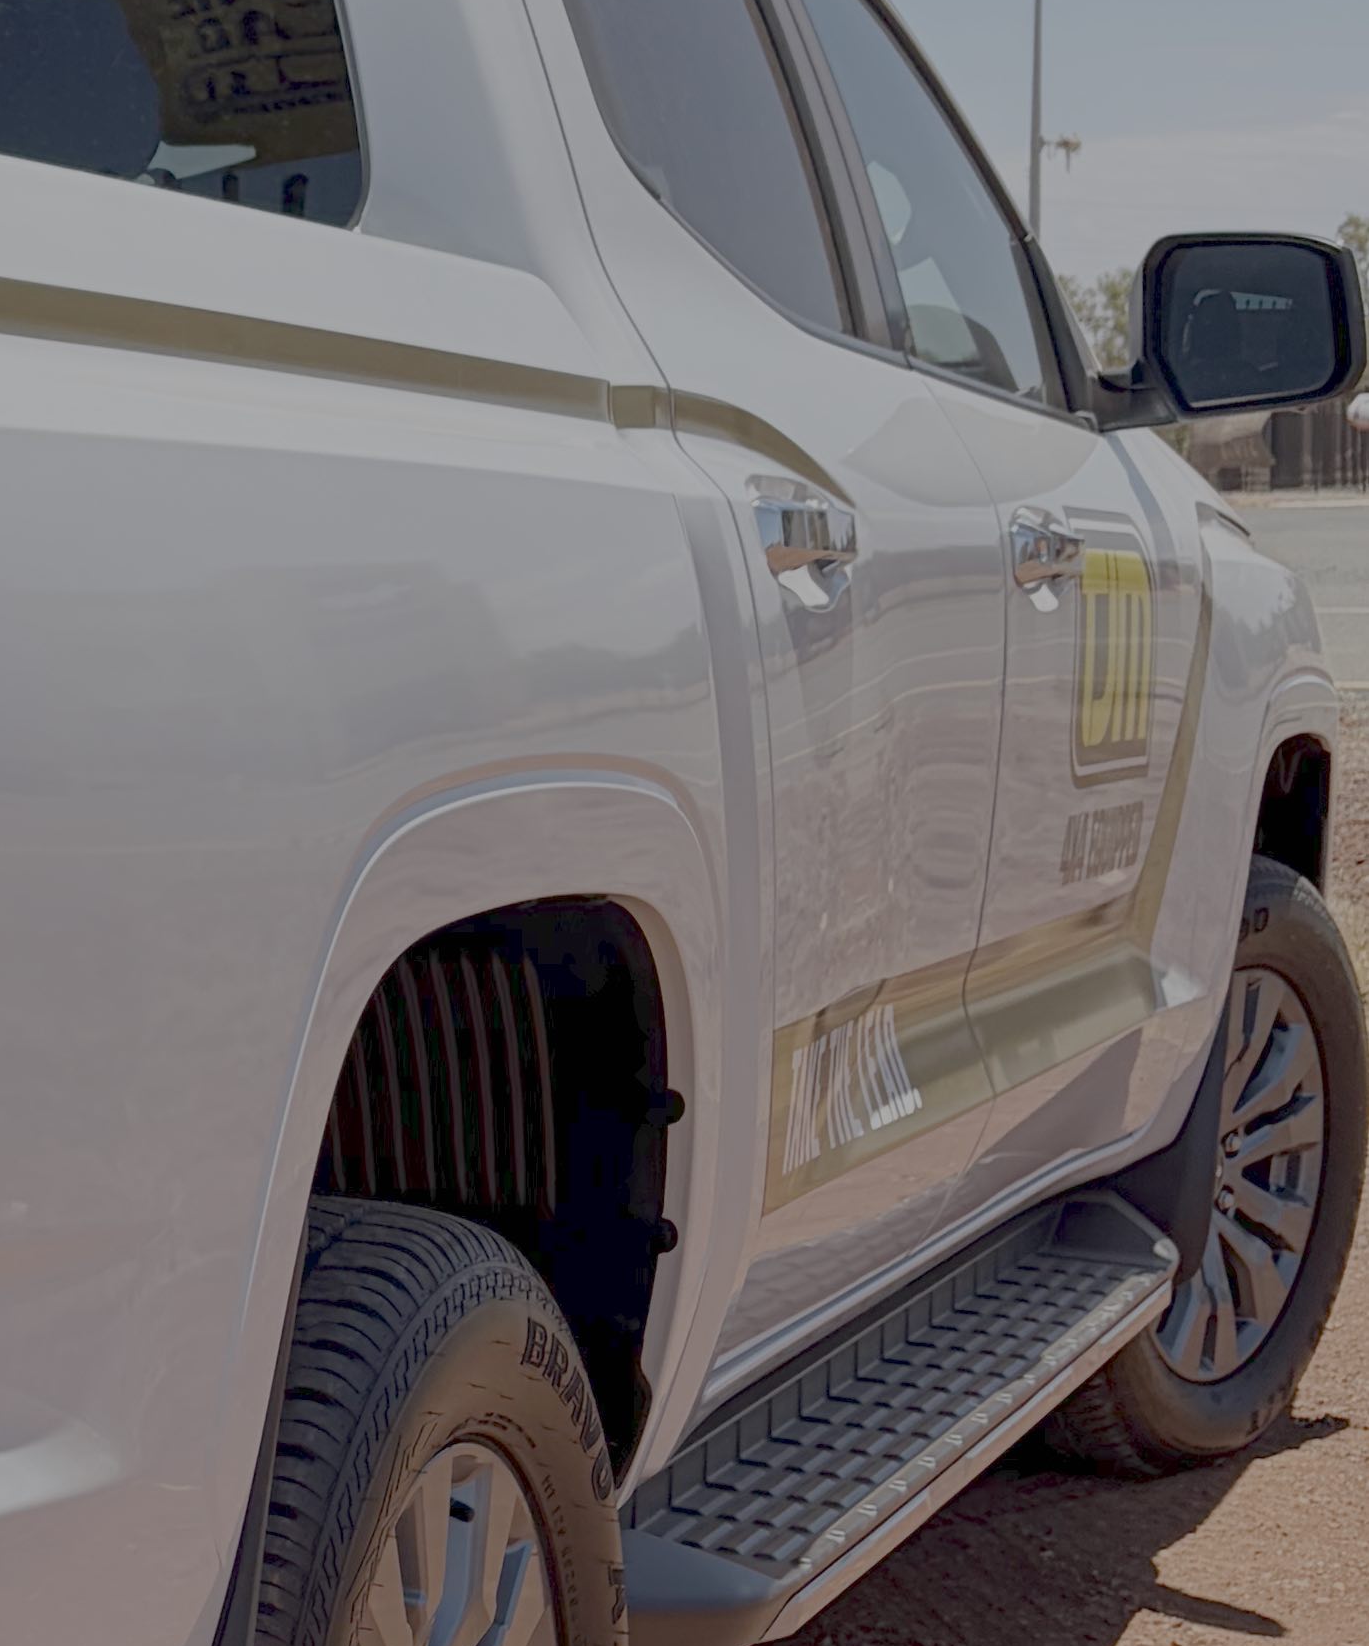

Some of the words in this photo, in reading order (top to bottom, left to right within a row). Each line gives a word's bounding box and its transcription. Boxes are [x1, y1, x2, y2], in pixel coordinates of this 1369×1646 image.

[781, 1034, 828, 1177] TAKE
[826, 1019, 865, 1150] THE
[856, 1002, 923, 1132] LEAD.
[521, 1316, 614, 1503] BRAVO
